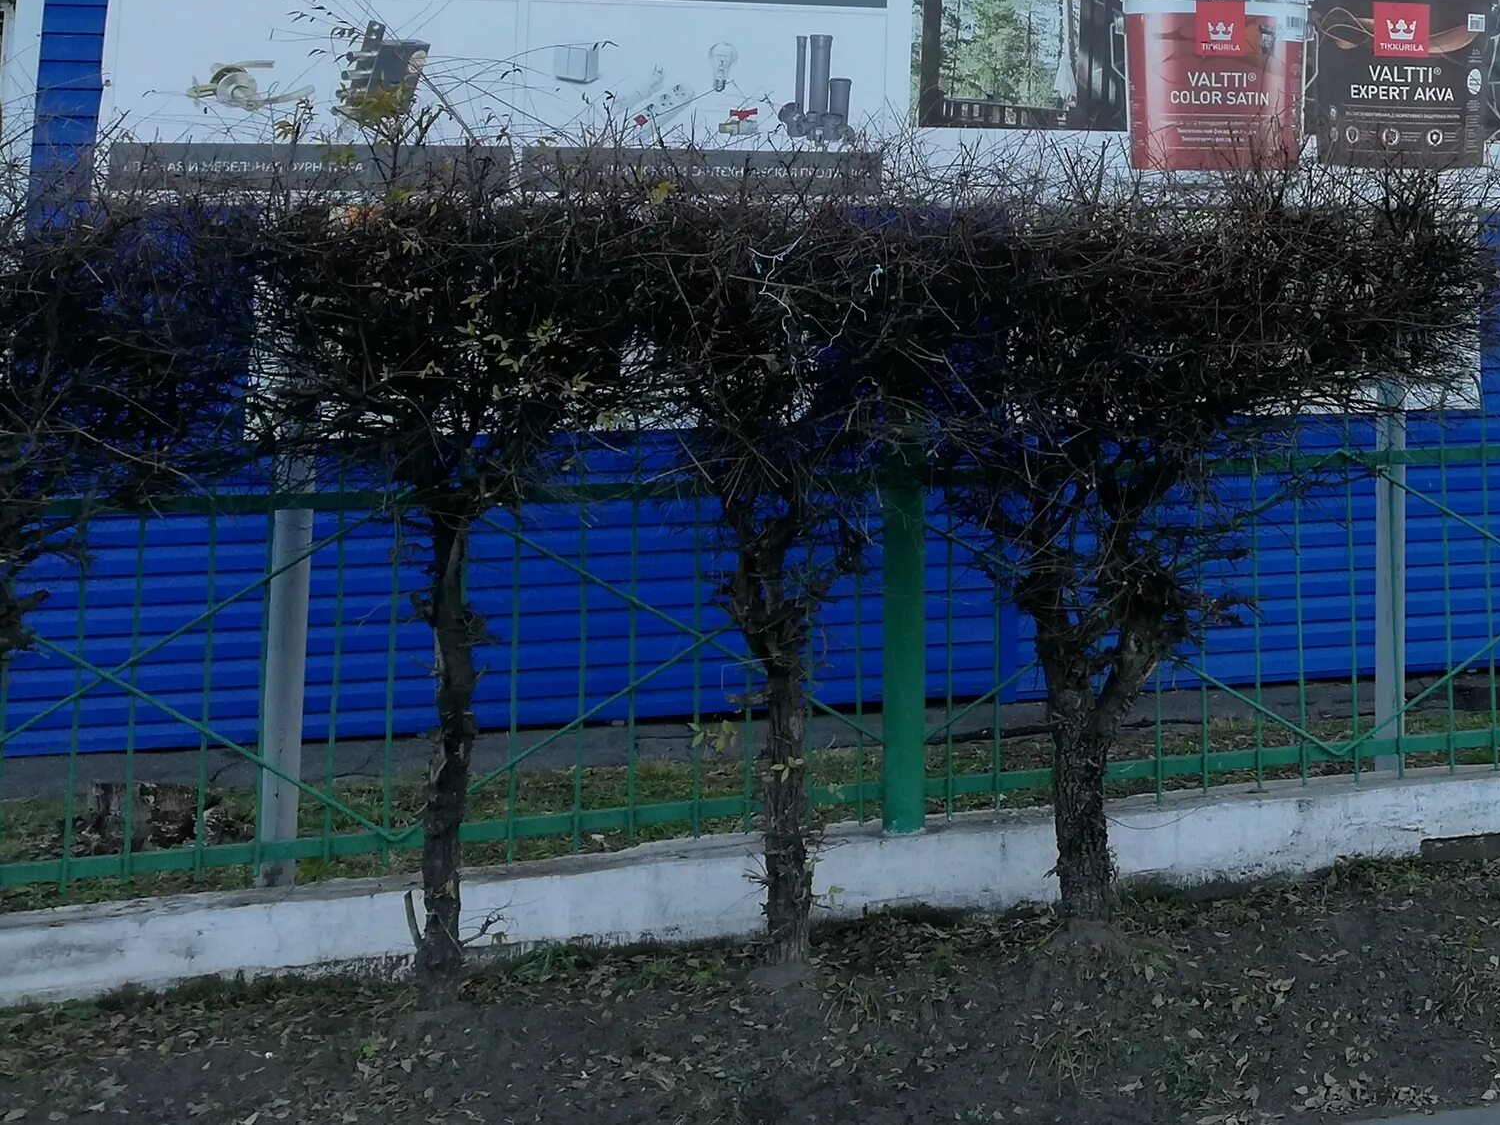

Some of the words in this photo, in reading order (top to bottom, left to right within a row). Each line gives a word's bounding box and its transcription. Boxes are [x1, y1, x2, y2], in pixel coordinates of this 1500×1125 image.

[1379, 42, 1425, 53] TIKKURILA
[1170, 90, 1222, 105] COLOR
[1226, 91, 1270, 105] SATIN
[1350, 84, 1410, 101] EXPERT
[1413, 86, 1455, 102] AKVA
